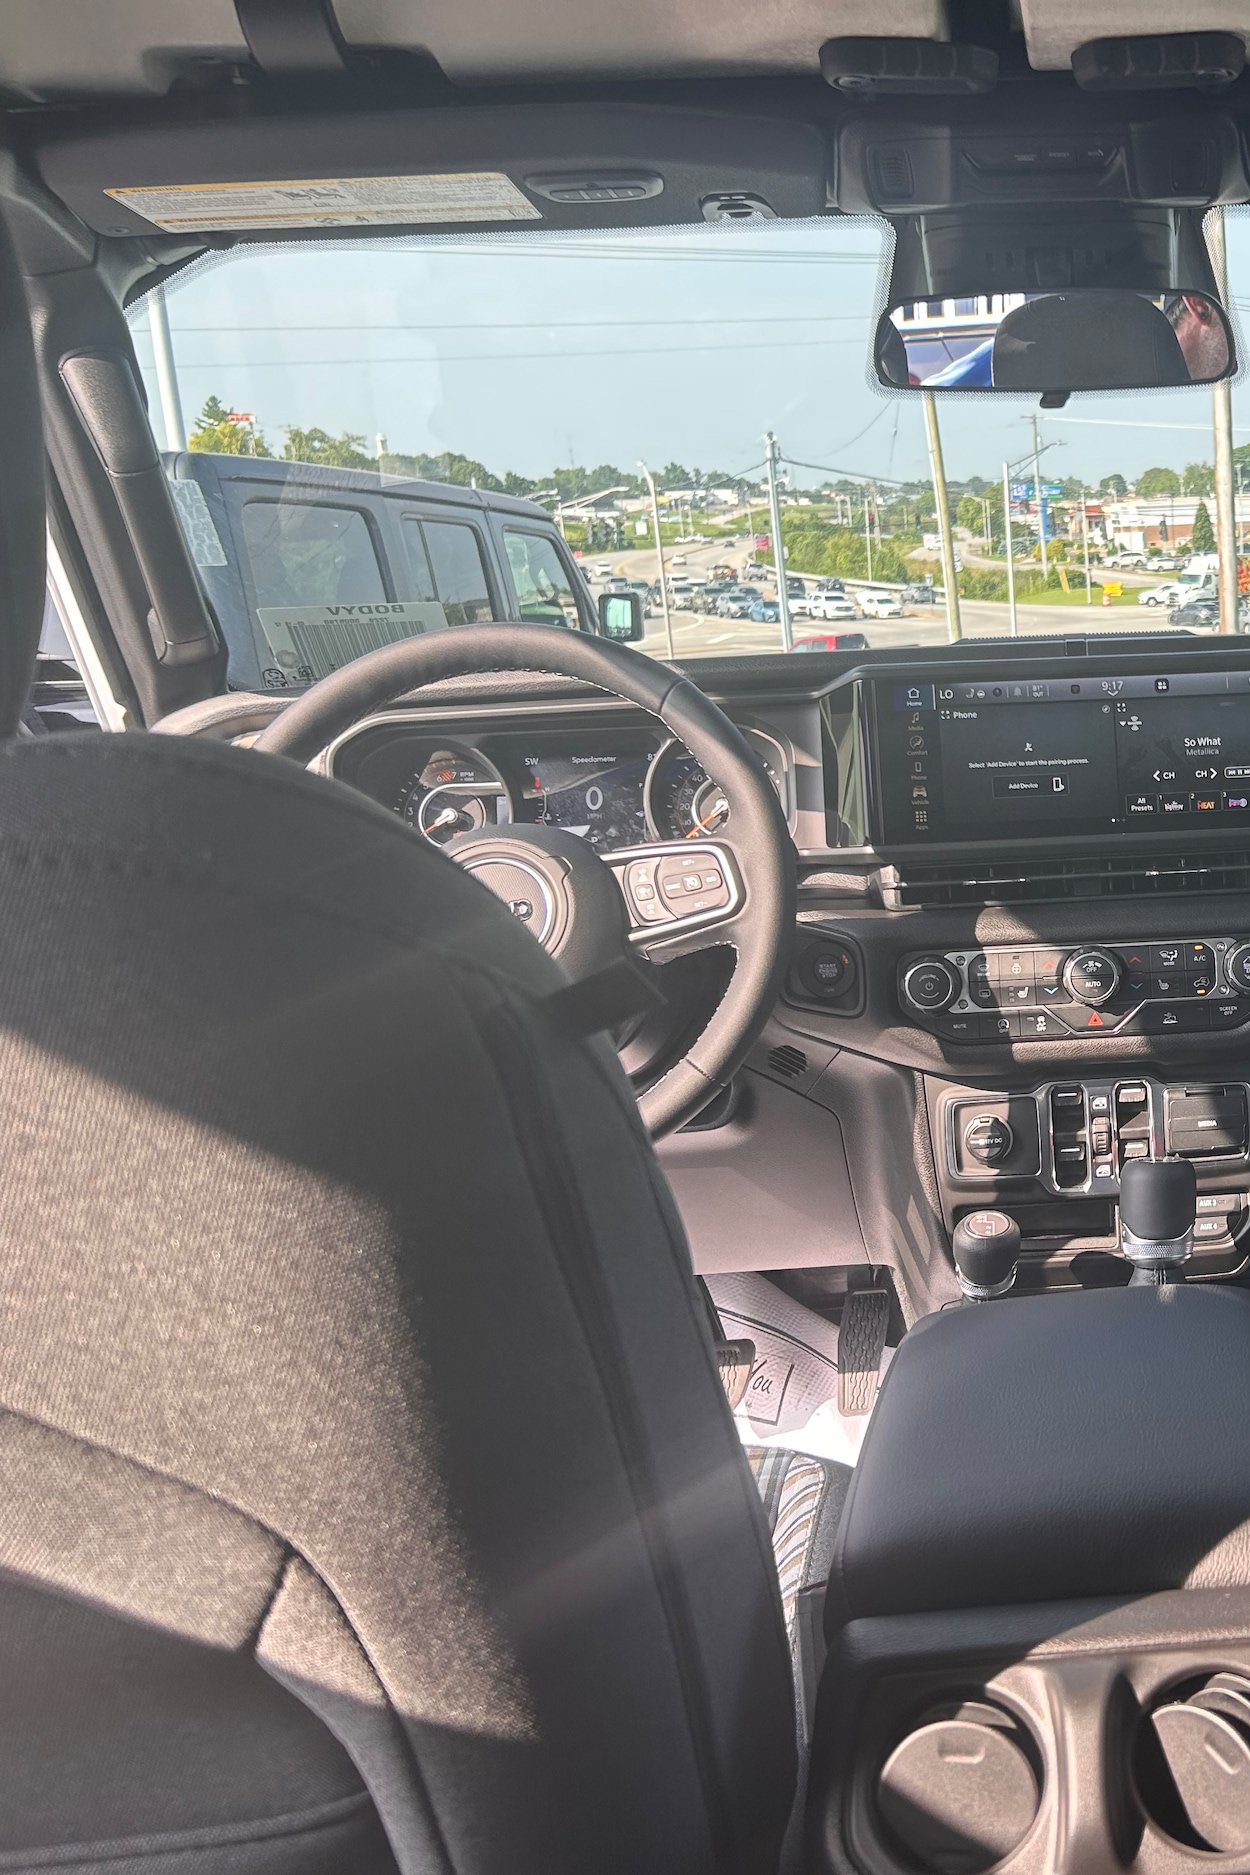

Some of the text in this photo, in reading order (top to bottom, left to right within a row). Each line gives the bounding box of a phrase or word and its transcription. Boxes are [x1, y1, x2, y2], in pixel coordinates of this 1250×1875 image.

[1102, 680, 1124, 691] 9:17
[939, 689, 954, 699] LO
[953, 710, 978, 720] Phone
[1184, 736, 1222, 747] So What
[1186, 748, 1220, 756] Metallica
[524, 758, 539, 766] SW
[572, 756, 616, 764] Speedometer
[452, 772, 456, 780] 7
[692, 774, 703, 782] 40
[1162, 771, 1176, 780] CH
[1195, 770, 1208, 778] CH
[1008, 782, 1019, 790] Add
[684, 788, 694, 796] 30
[586, 786, 604, 811] 0
[1130, 804, 1154, 812] Presets
[1197, 800, 1216, 810] HEAT
[408, 807, 413, 815] 3
[1198, 1120, 1217, 1128] MEDIA
[1199, 1199, 1212, 1208] AUX
[1200, 1222, 1212, 1230] AUX
